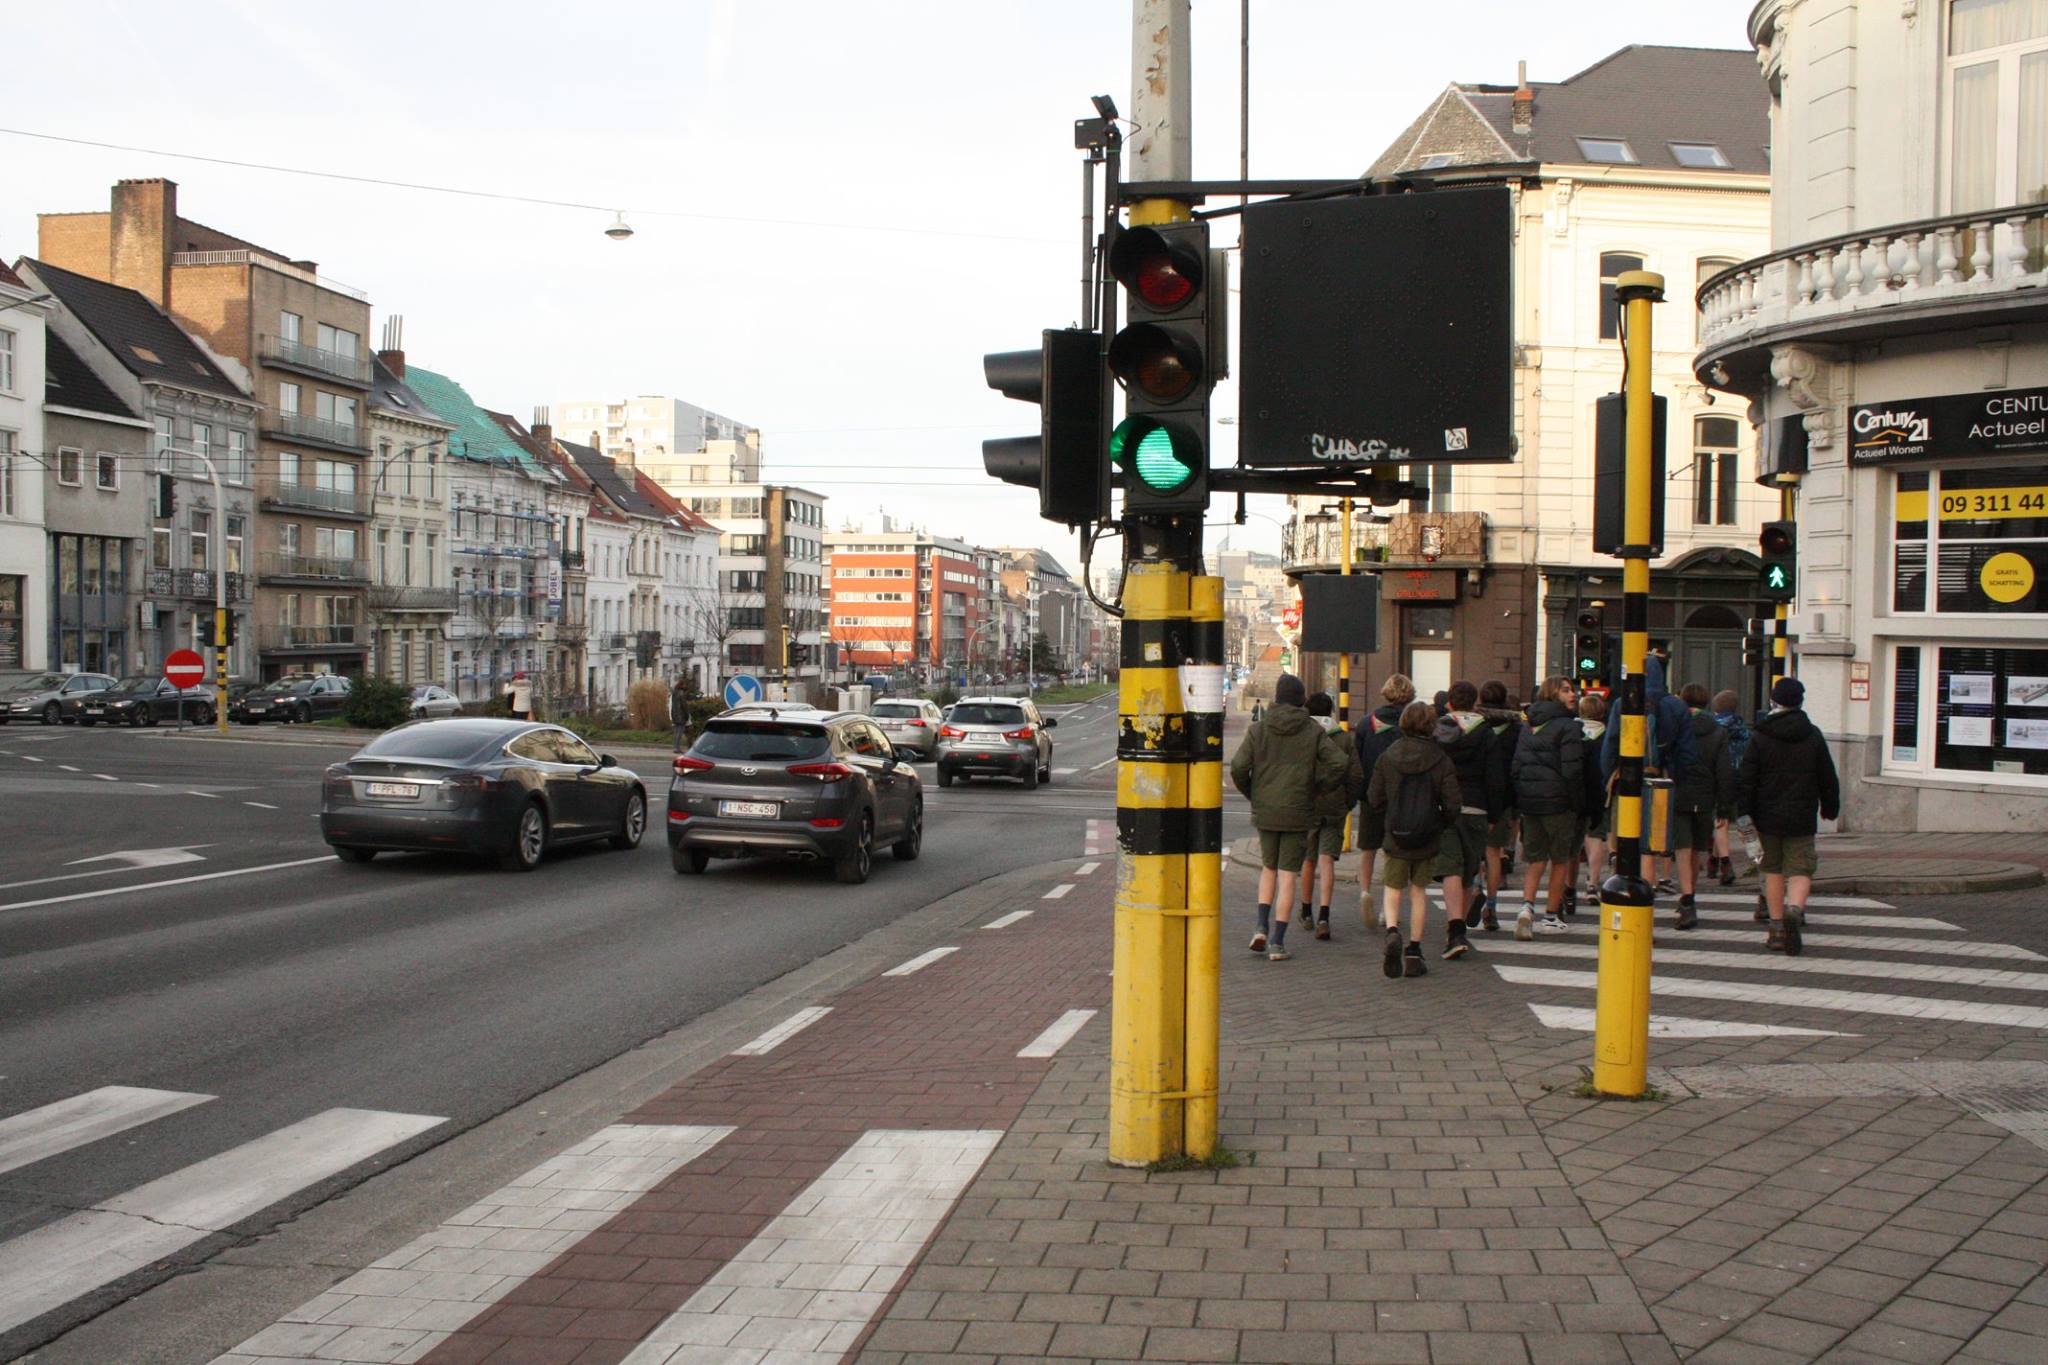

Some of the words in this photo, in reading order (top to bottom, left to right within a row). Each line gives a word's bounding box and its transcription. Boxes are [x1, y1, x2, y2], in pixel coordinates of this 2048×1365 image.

[1853, 409, 1916, 432] Century
[1908, 418, 1929, 442] 21
[1968, 418, 2045, 438] Actueel
[1854, 447, 1887, 459] Actueel
[1889, 445, 1924, 456] Wonen
[1942, 496, 1967, 513] 09
[1973, 494, 2011, 512] 311
[2018, 493, 2045, 510] 44
[728, 803, 776, 814] 1-NSC-458
